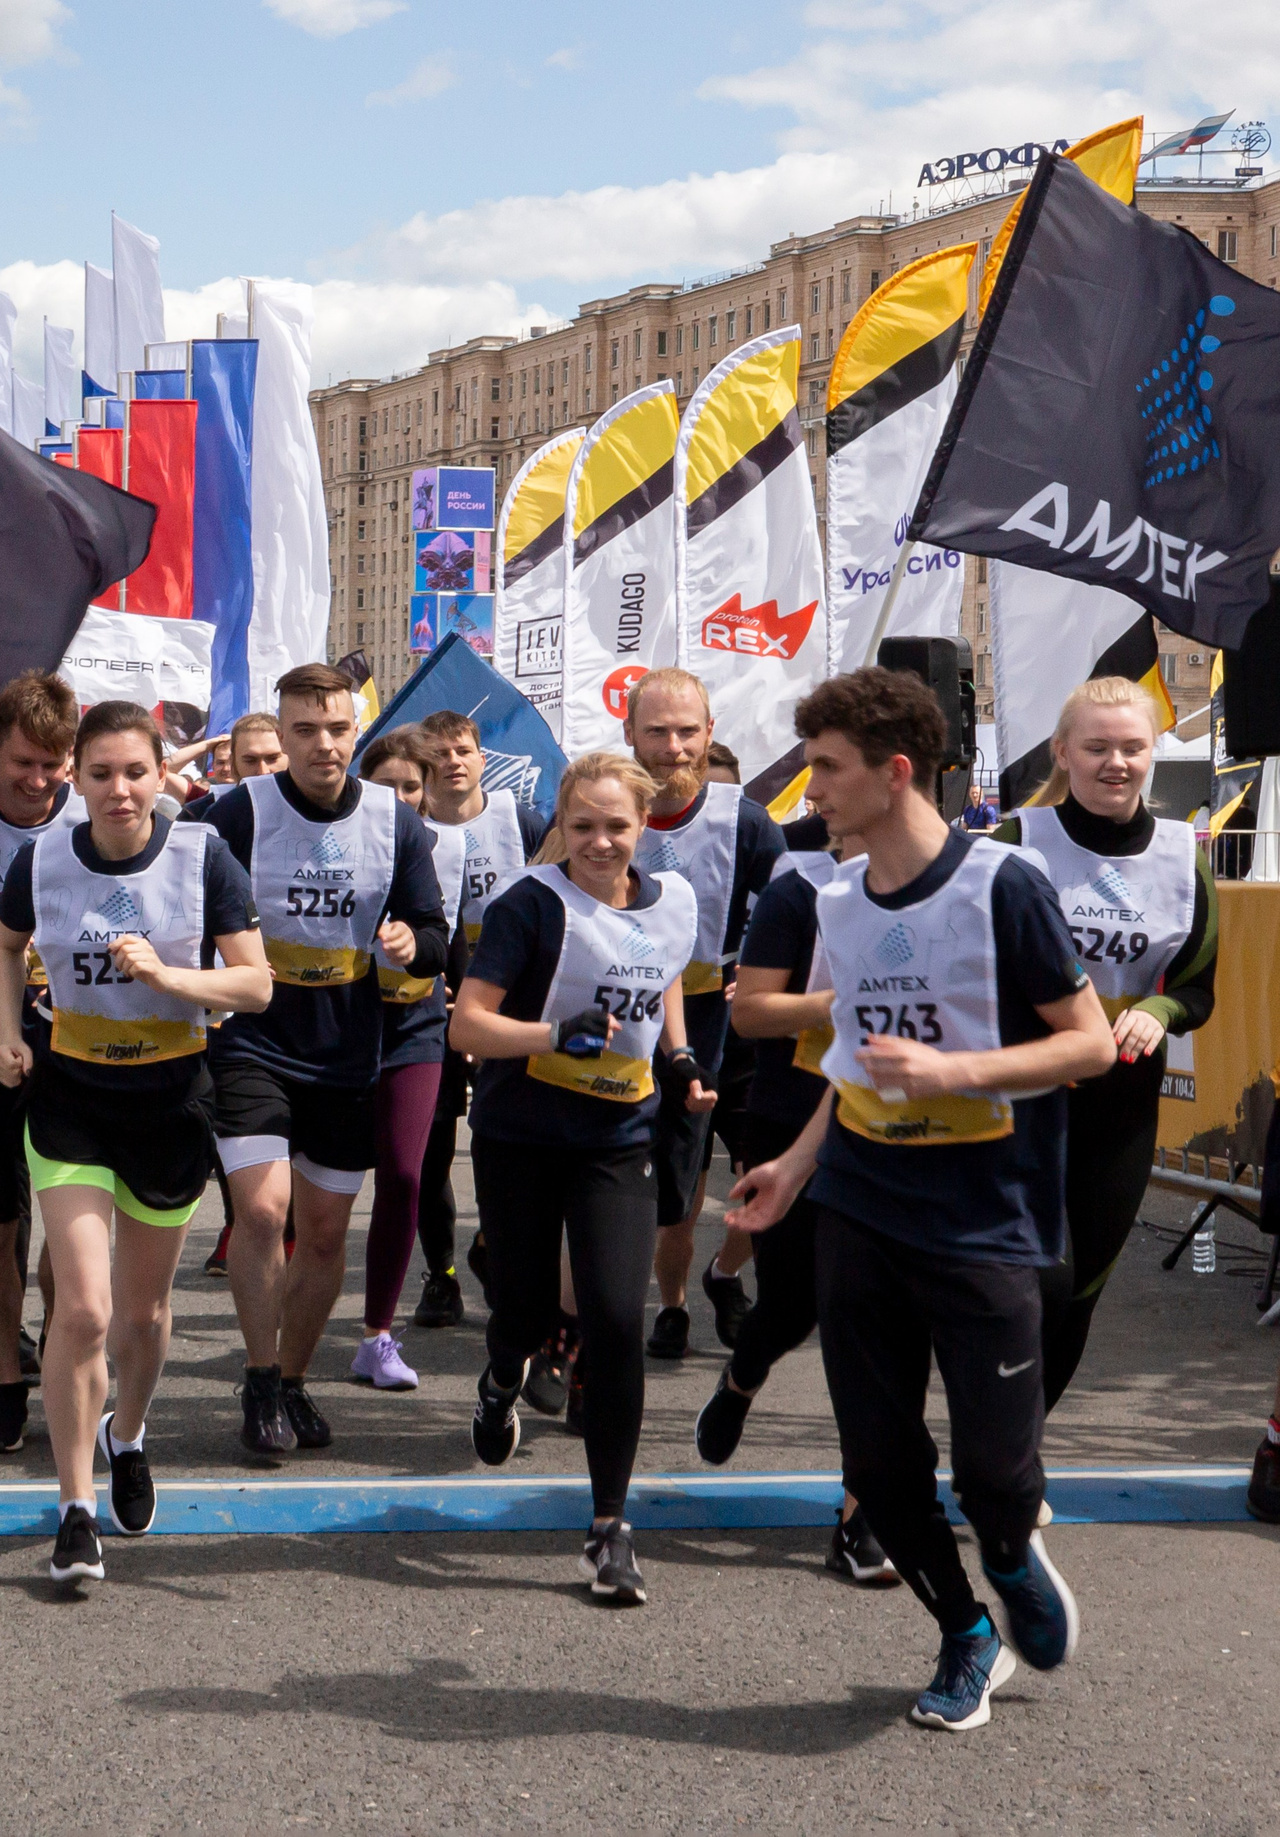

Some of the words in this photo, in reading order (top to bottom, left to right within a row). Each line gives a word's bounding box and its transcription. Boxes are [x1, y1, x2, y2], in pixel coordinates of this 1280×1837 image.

[447, 491, 471, 500] ДЕНЬ
[447, 502, 485, 510] РОССИИ
[842, 548, 961, 594] Урасиб
[617, 573, 646, 653] KUDAGO
[713, 611, 760, 627] protein
[705, 622, 789, 657] REX
[293, 869, 354, 881] AMTEX
[286, 887, 355, 918] 5256
[1071, 905, 1145, 923] AMTEX
[78, 930, 151, 943] AMTX
[1068, 926, 1149, 965] 5249
[606, 965, 664, 979] AMTEX
[858, 976, 930, 992] AMTEX
[594, 985, 662, 1022] 5264
[855, 1003, 943, 1045] 5263
[1160, 1075, 1173, 1094] GY
[1174, 1078, 1195, 1098] 104.2
